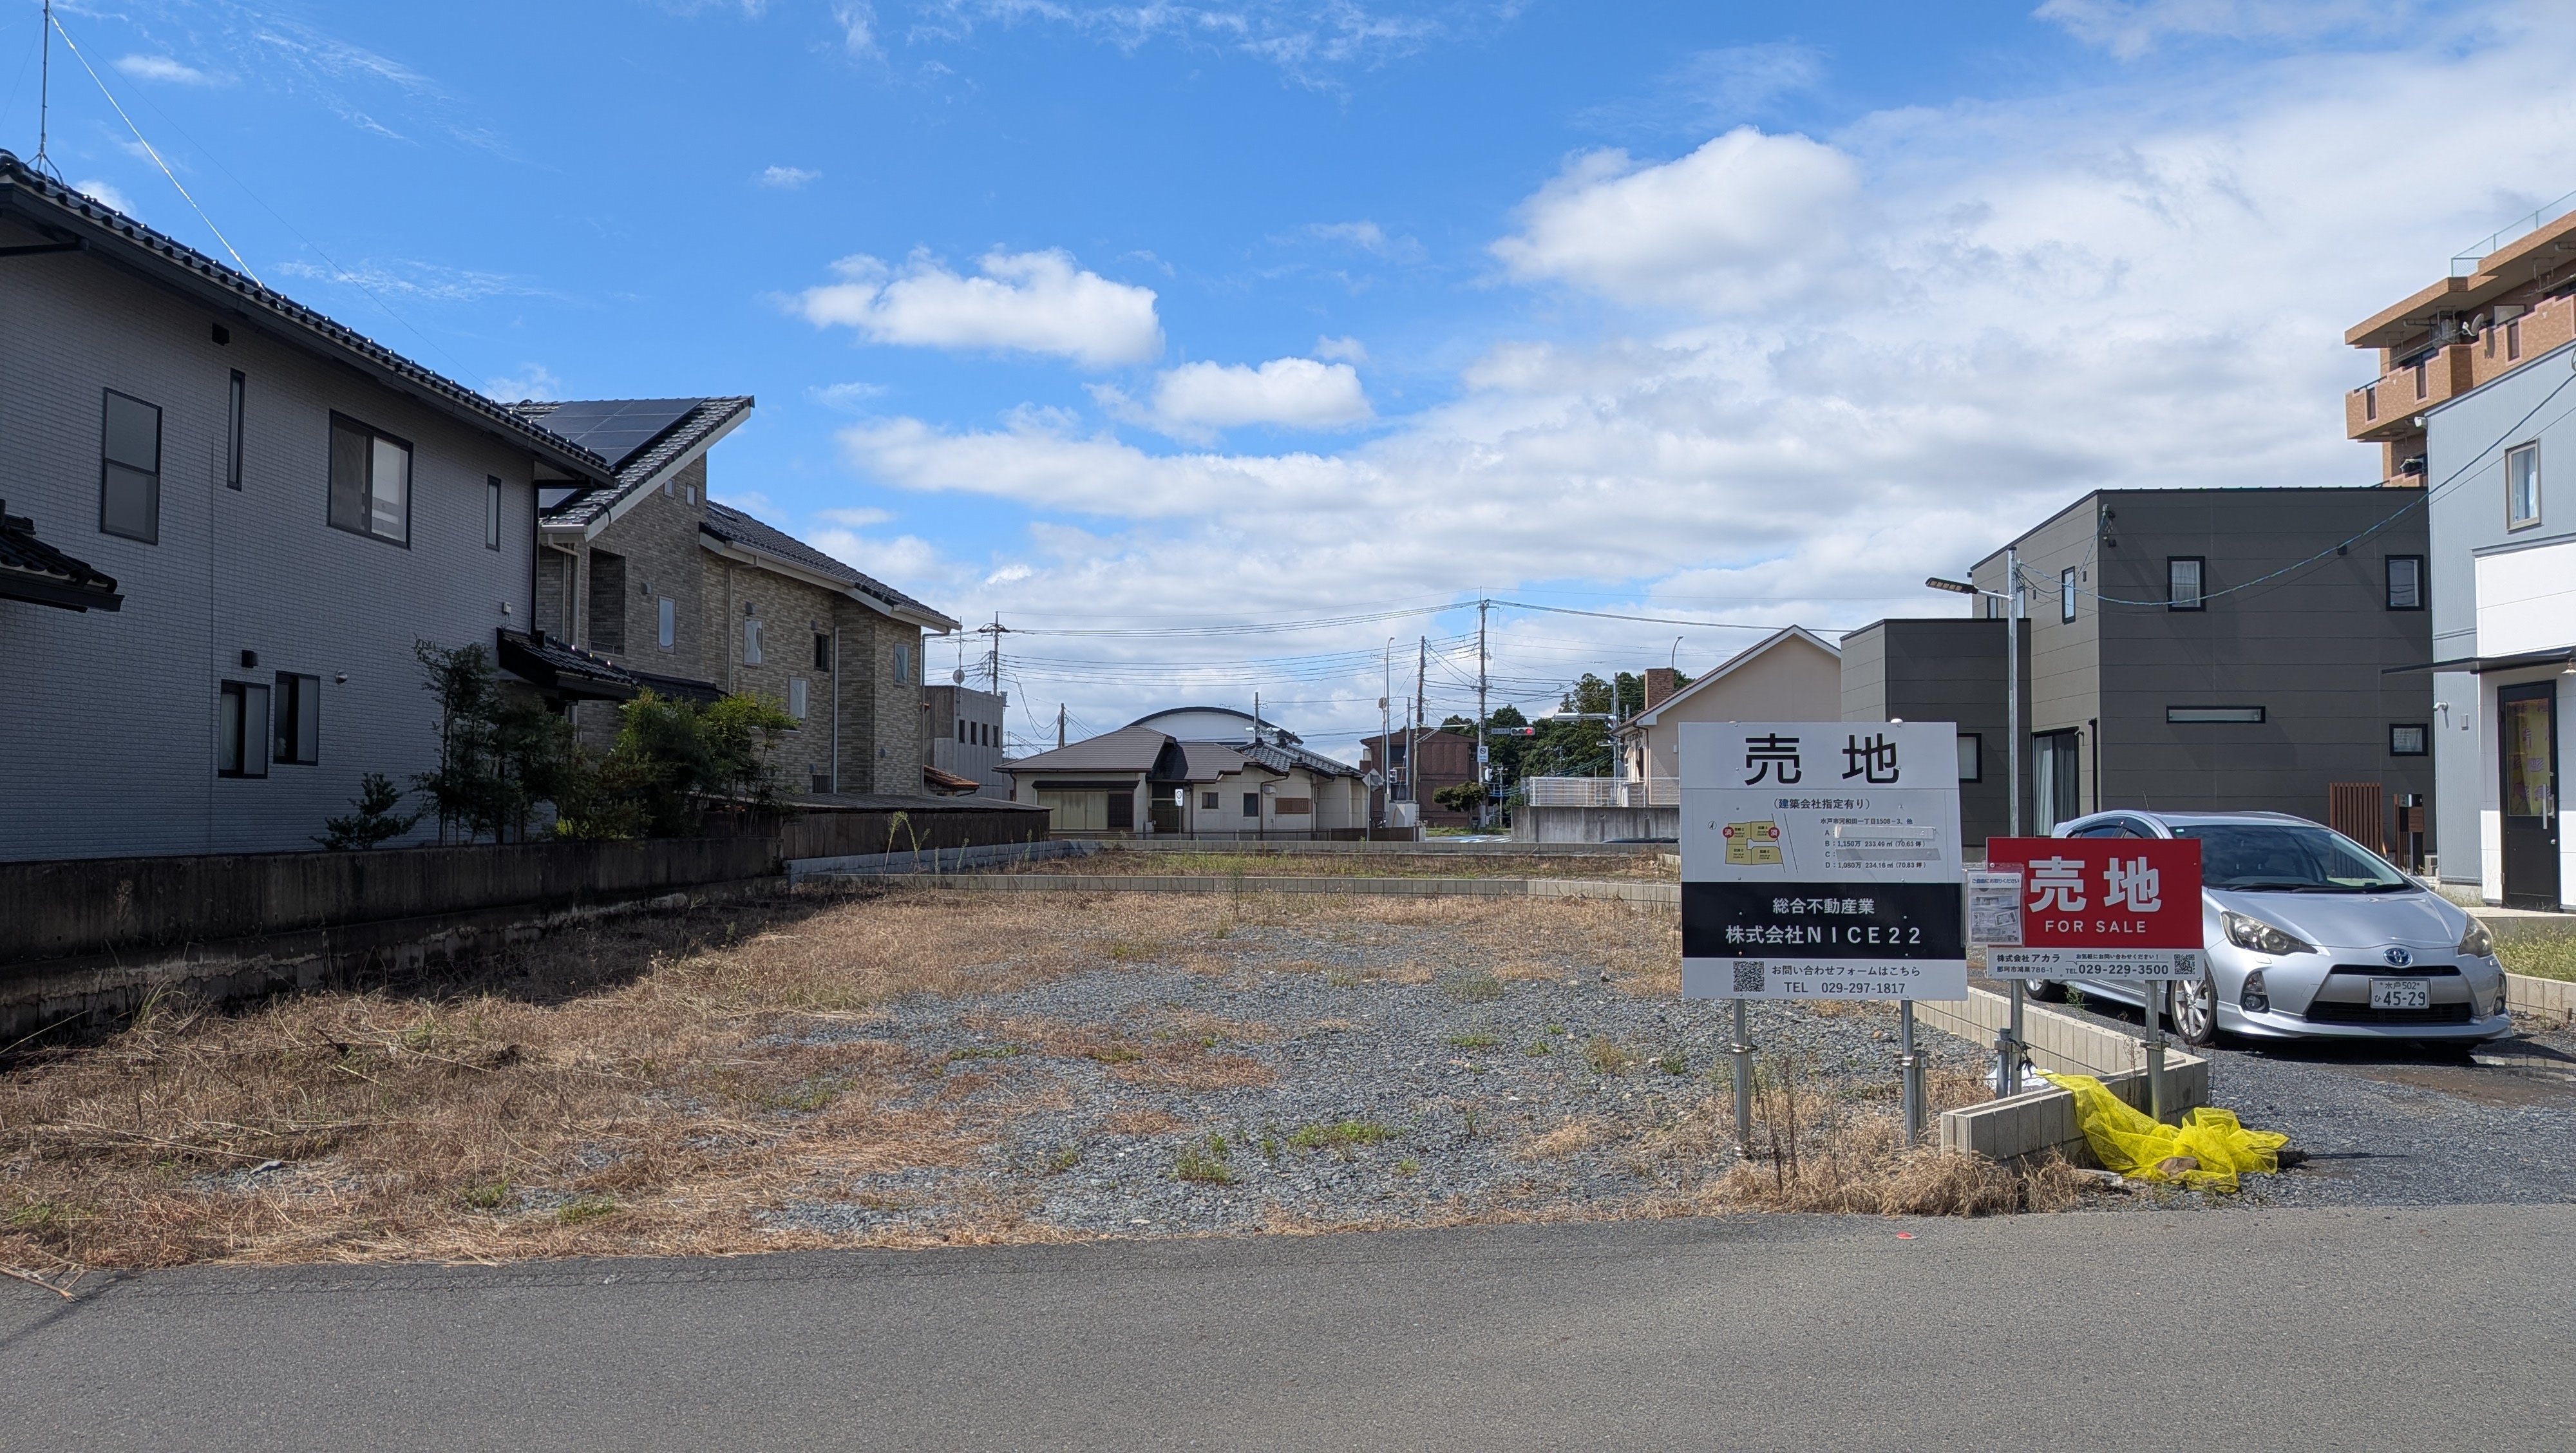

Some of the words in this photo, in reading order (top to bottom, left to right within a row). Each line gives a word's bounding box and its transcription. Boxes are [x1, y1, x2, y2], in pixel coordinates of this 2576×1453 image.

[2028, 855, 2162, 913] 売地
[1772, 898, 1875, 915] 総合不動産業
[2045, 920, 2084, 933] FOR
[2096, 920, 2146, 933] SALE
[1997, 954, 2060, 963] 株式会社アカラ
[1772, 965, 1920, 976] お問い合わせフォームはこちら
[2078, 964, 2169, 975] 029-229-3500
[1784, 982, 1808, 993] TEL
[1821, 982, 1906, 994] 029-297-1817
[2383, 991, 2426, 1006] 45-29
